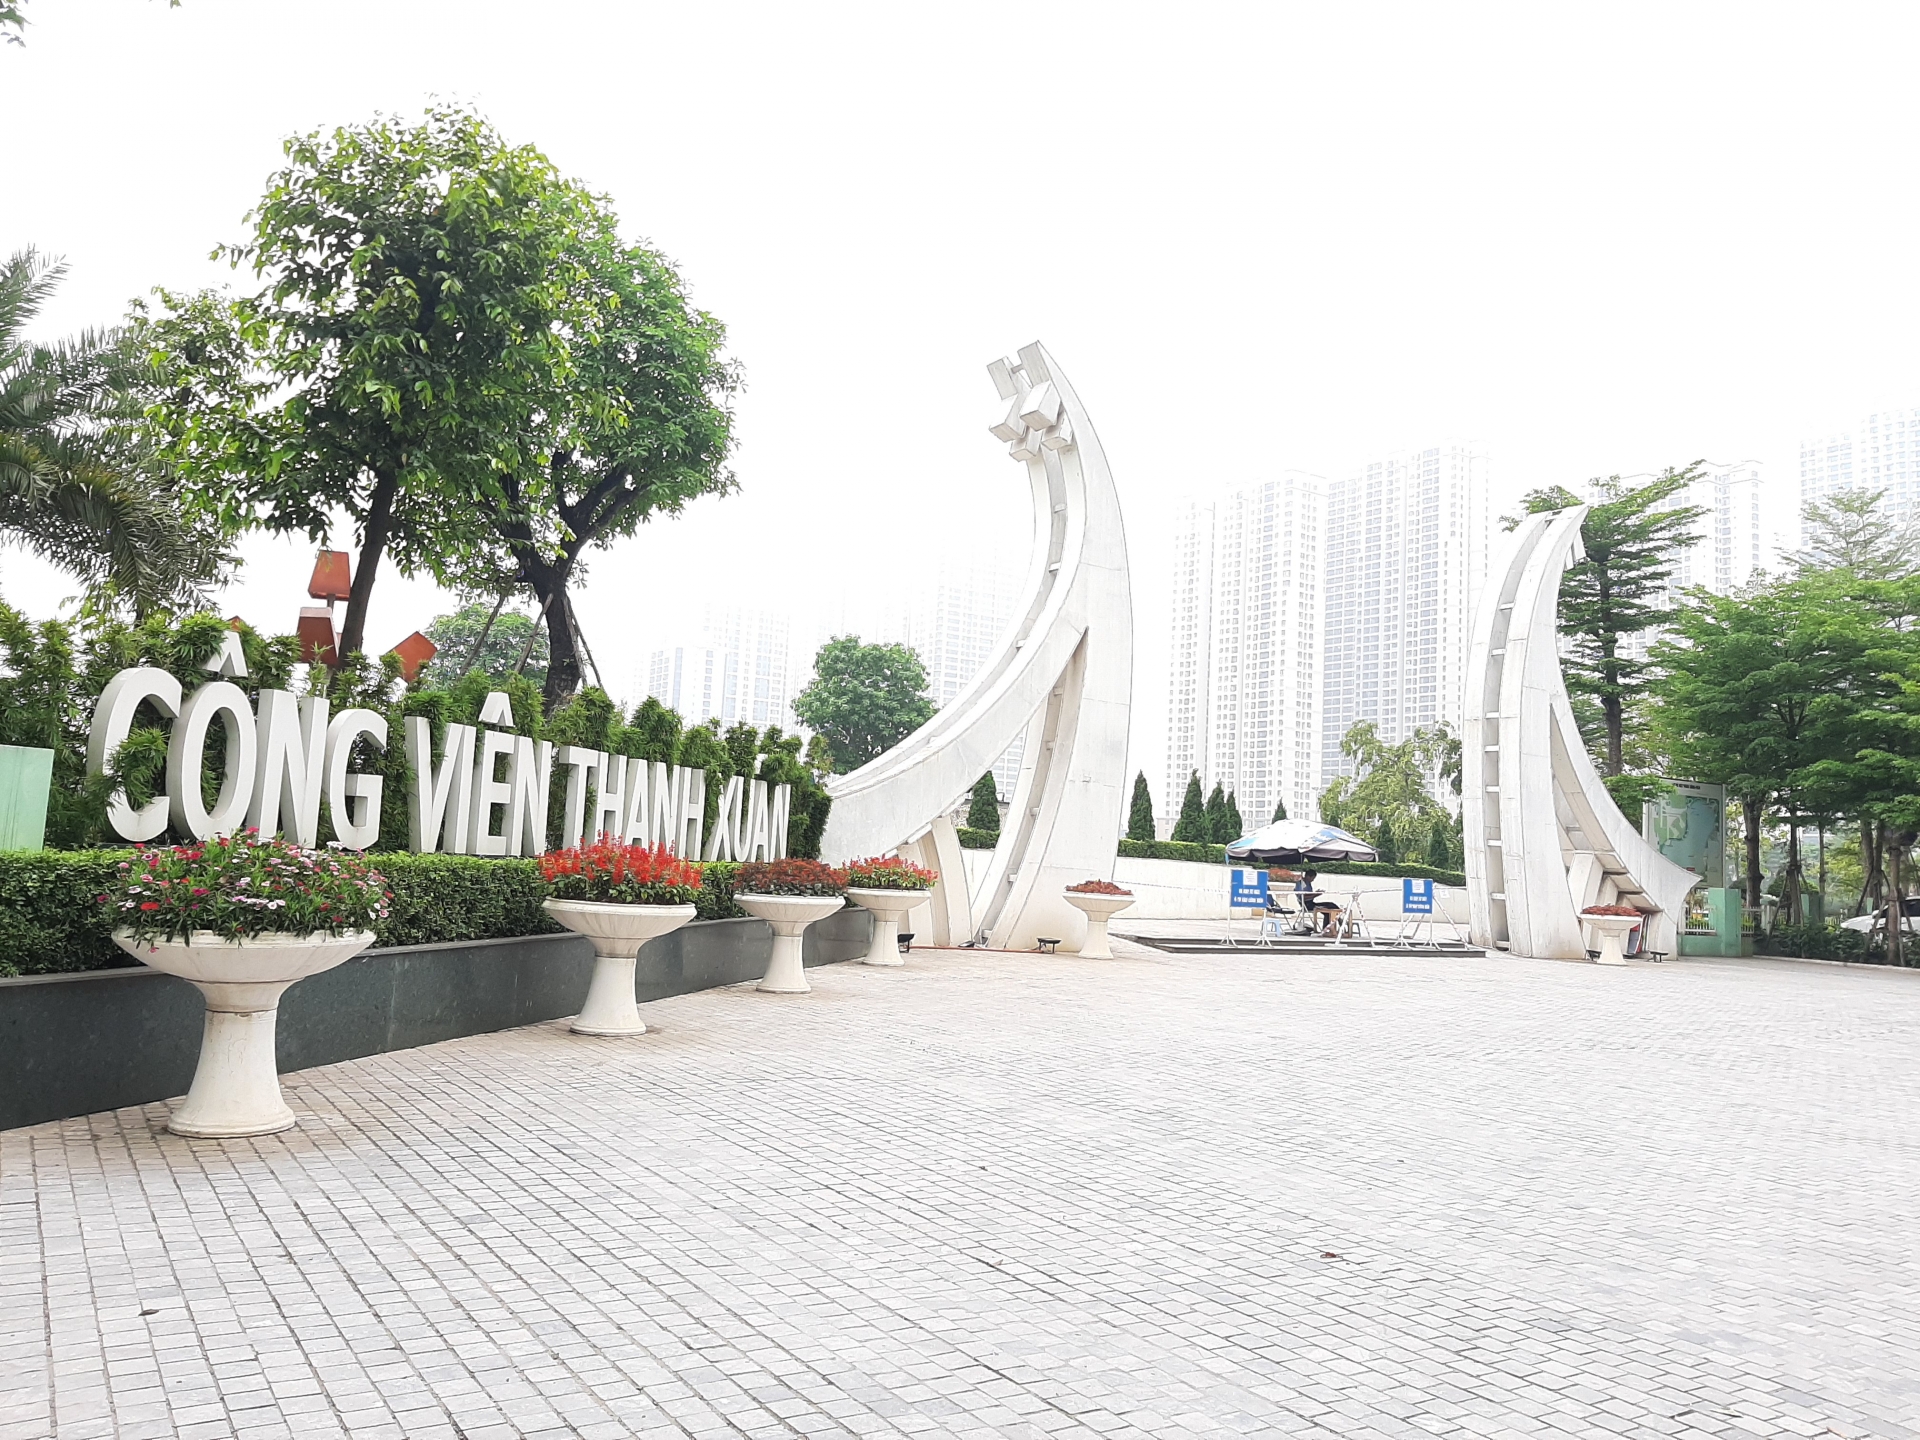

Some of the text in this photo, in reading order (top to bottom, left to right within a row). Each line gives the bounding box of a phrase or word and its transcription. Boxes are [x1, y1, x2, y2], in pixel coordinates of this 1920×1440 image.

[87, 630, 388, 851] CÔNG
[404, 691, 553, 857] VIÊN
[558, 745, 706, 862] THANH
